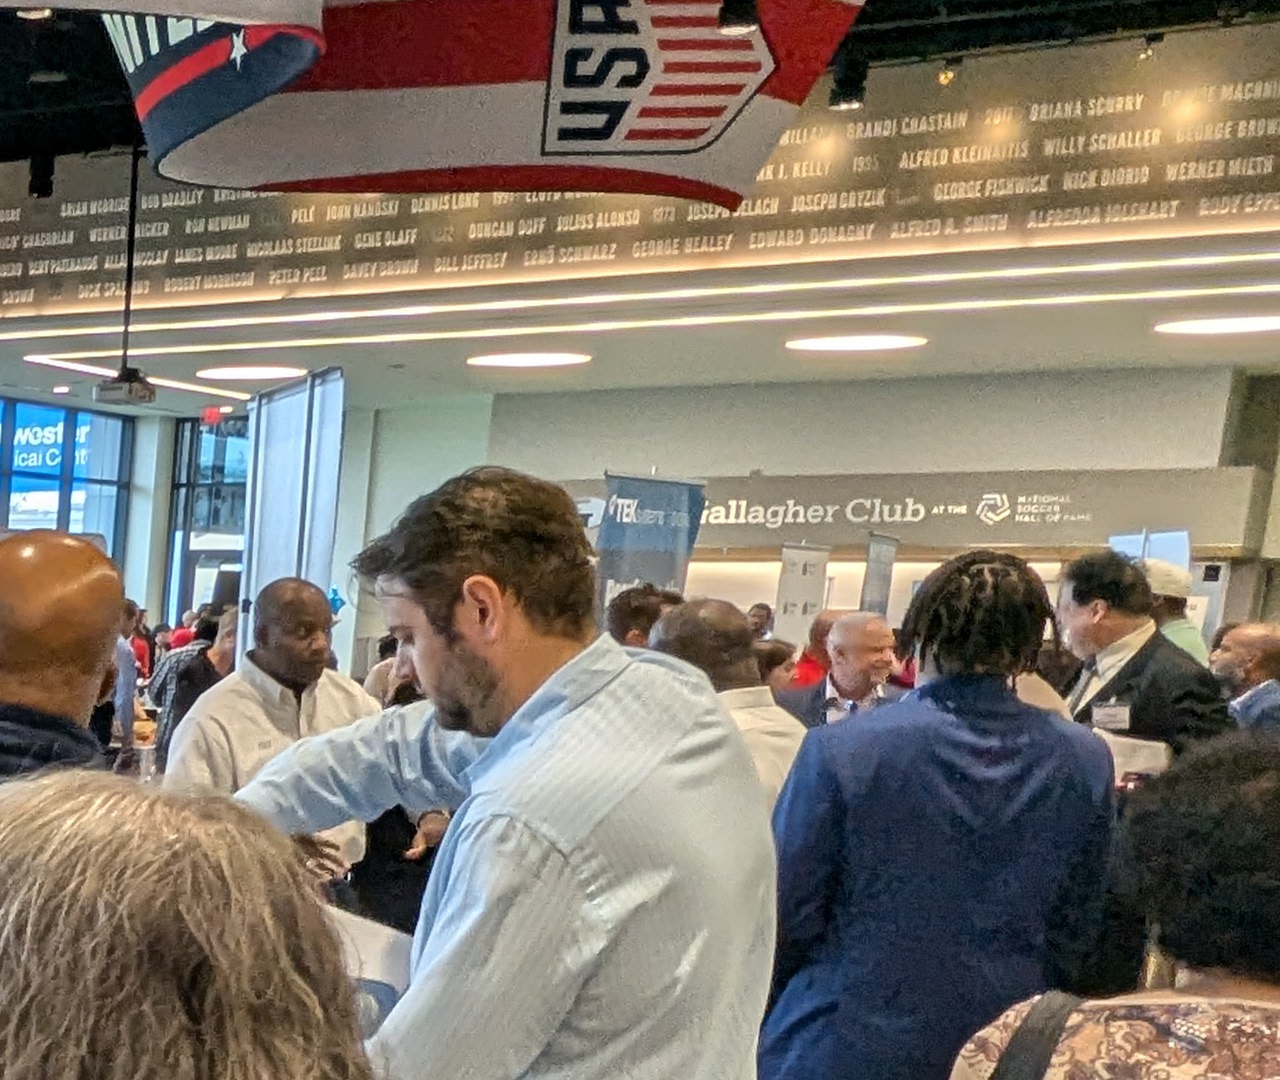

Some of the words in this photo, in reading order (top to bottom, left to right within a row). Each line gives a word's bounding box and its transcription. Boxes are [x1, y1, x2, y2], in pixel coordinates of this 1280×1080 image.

[557, 0, 651, 141] USA
[1042, 135, 1085, 156] WILLY
[793, 160, 832, 179] KELLY
[845, 498, 925, 522] Club
